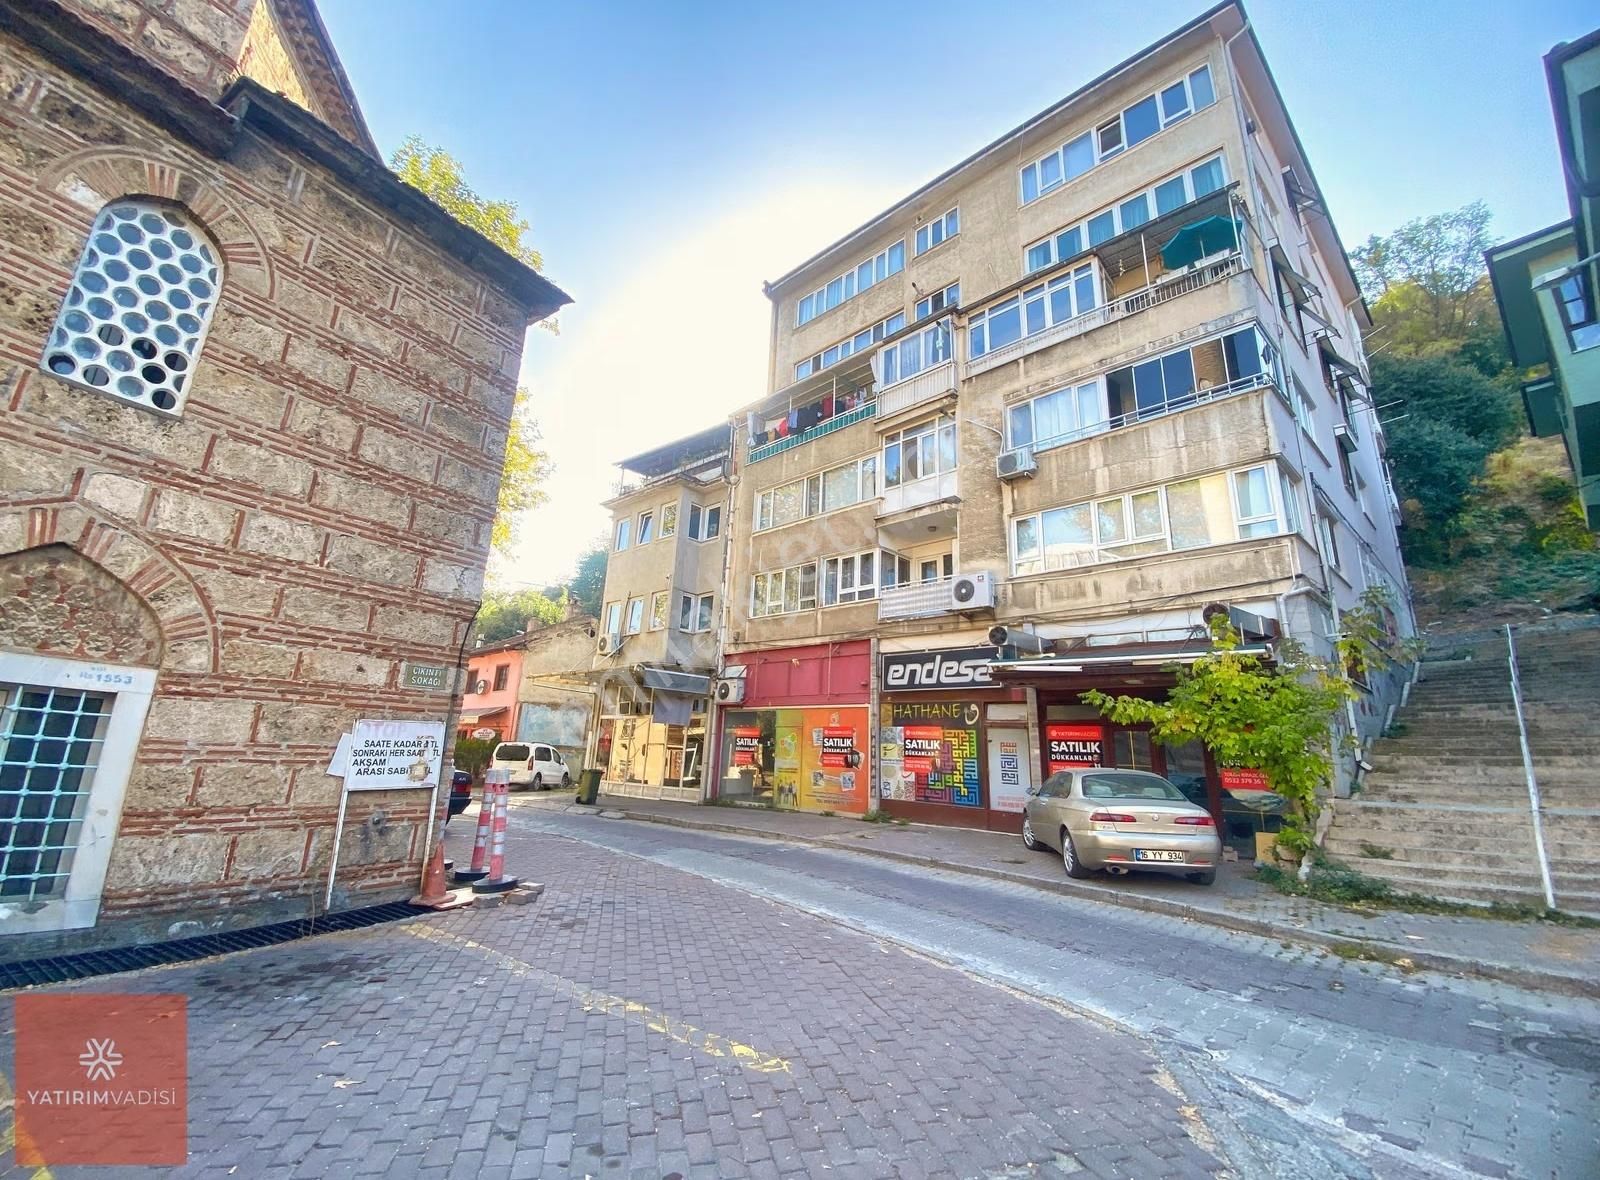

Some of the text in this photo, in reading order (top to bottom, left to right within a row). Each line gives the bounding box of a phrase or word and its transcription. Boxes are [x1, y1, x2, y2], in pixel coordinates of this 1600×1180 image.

[893, 703, 961, 719] HATHANE
[364, 739, 391, 748] SAATE
[393, 740, 422, 748] KADAR
[736, 737, 759, 746] SATILIK
[823, 738, 853, 747] SATILIK
[905, 739, 941, 750] SATILIK
[1051, 741, 1101, 753] SATILIK
[389, 749, 405, 757] HER
[352, 758, 387, 769] AKŞAM
[355, 767, 386, 776] ARASI
[1140, 851, 1182, 860] 16 YY 934
